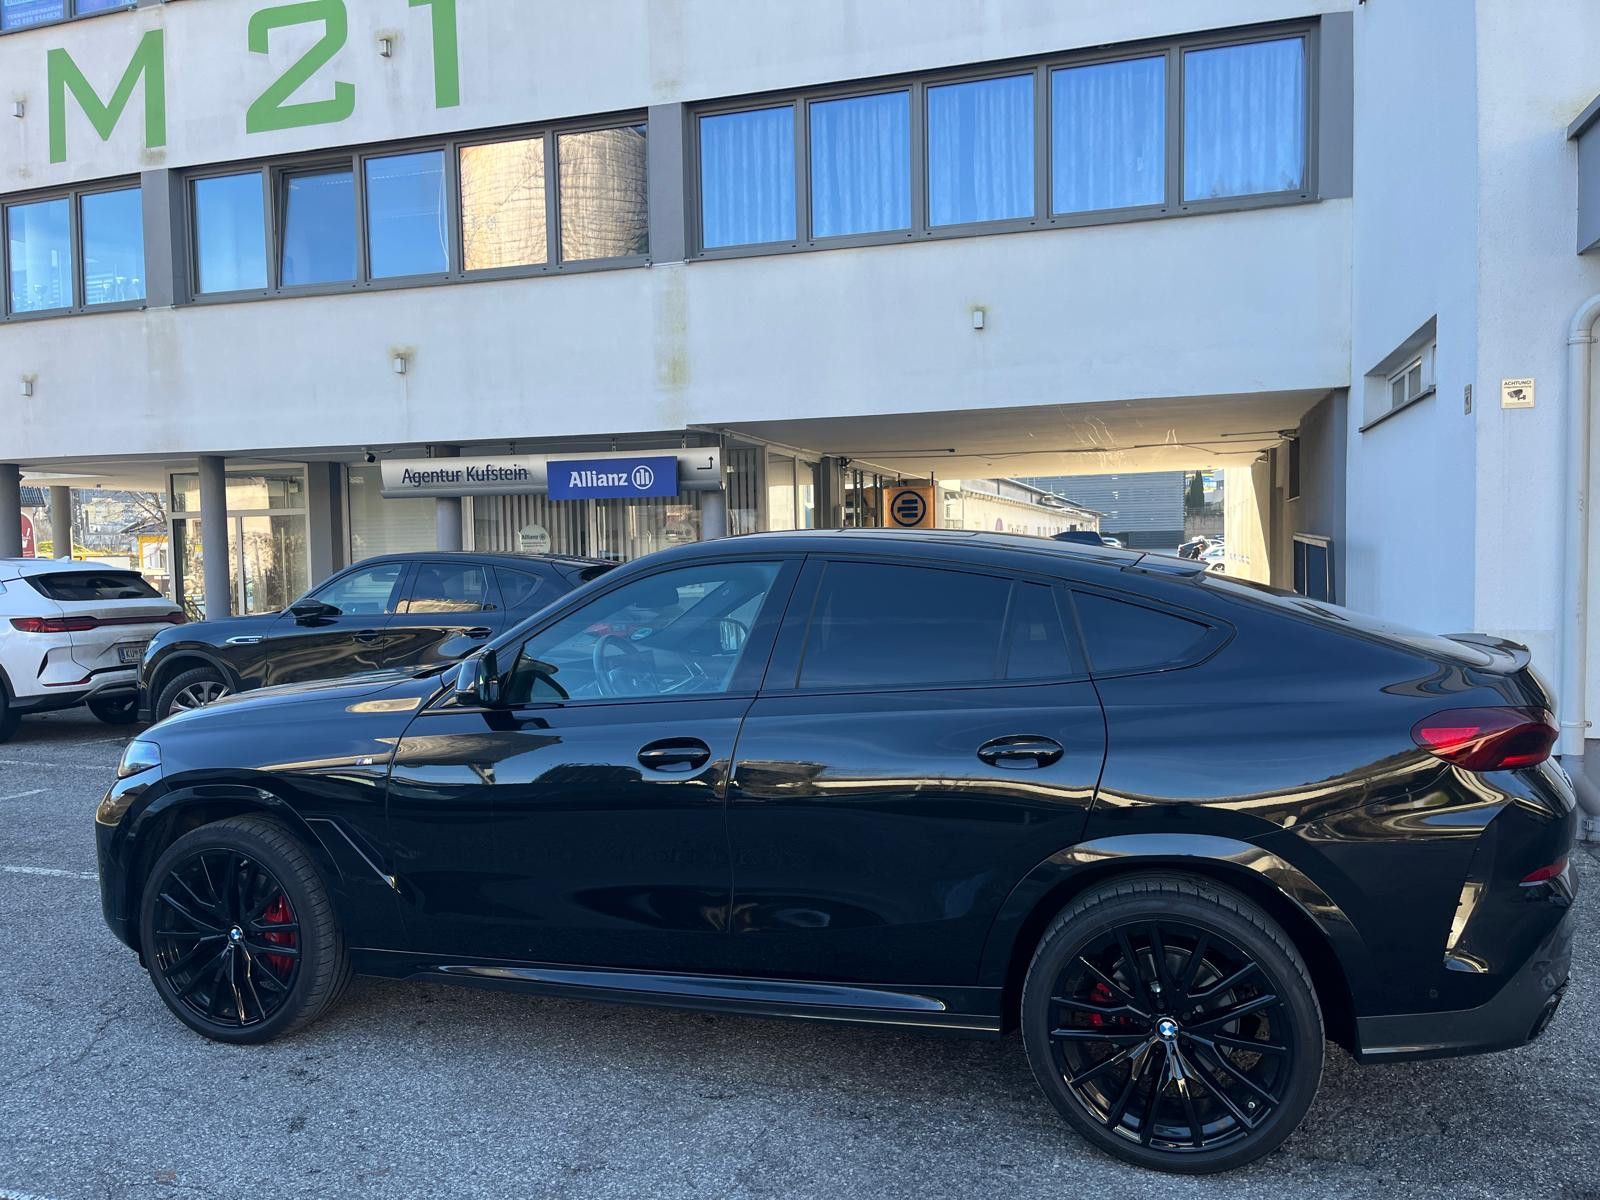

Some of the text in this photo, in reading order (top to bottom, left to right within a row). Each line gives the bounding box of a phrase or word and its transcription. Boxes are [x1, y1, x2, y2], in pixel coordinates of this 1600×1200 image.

[48, 29, 166, 163] M
[401, 464, 528, 488] Agentur Kufstein
[568, 470, 628, 488] Allianz
